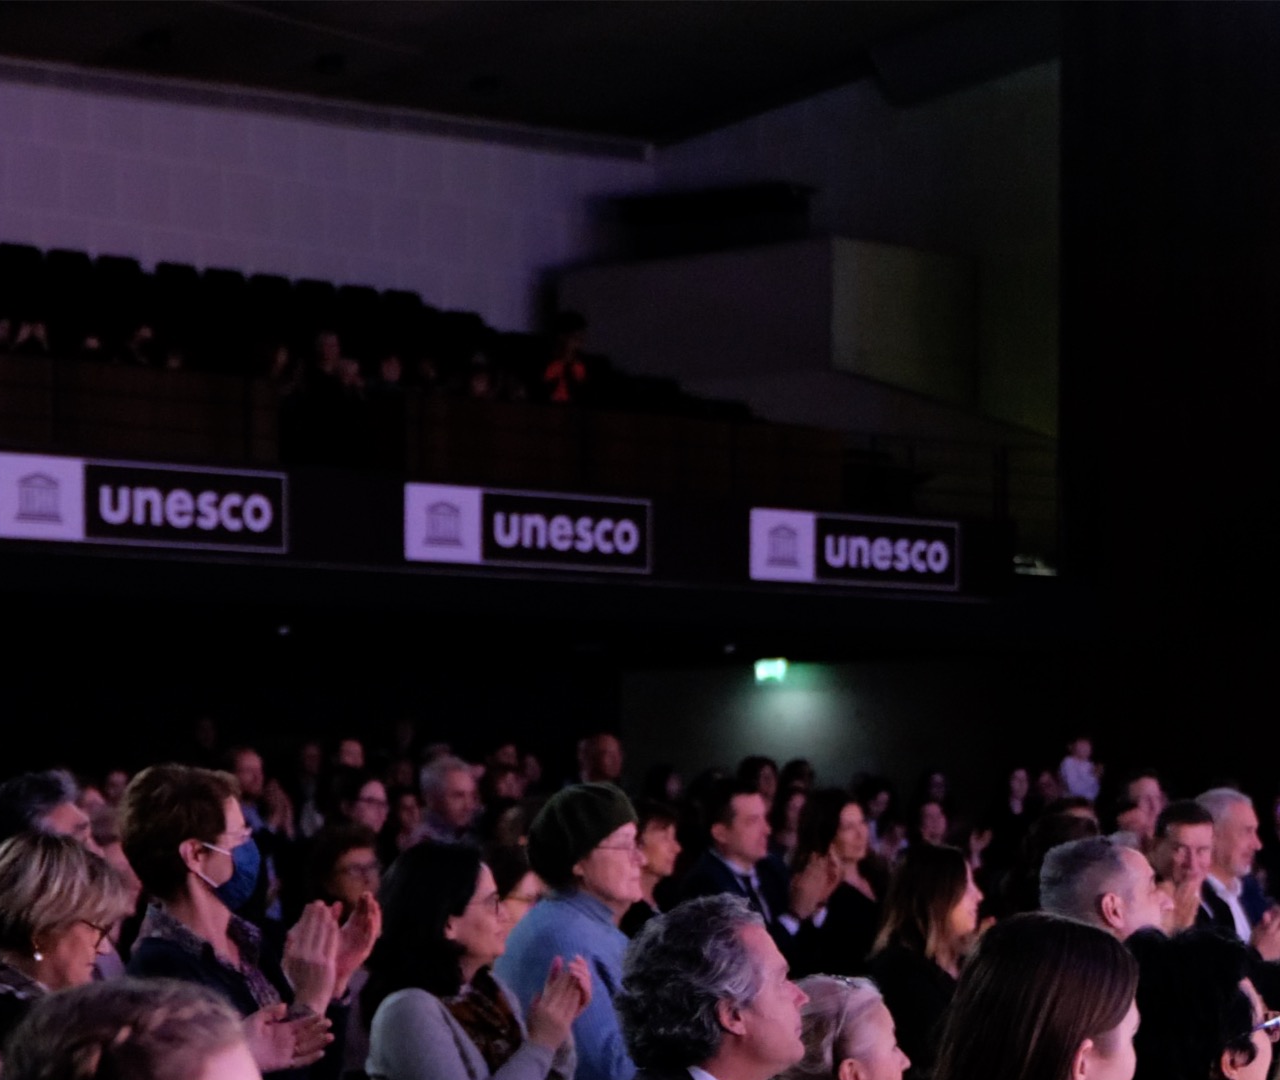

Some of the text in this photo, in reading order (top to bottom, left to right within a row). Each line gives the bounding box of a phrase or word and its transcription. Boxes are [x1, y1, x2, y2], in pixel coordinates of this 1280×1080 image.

[99, 485, 273, 533] unesco
[493, 511, 640, 555] unesco
[824, 535, 949, 573] unesco
